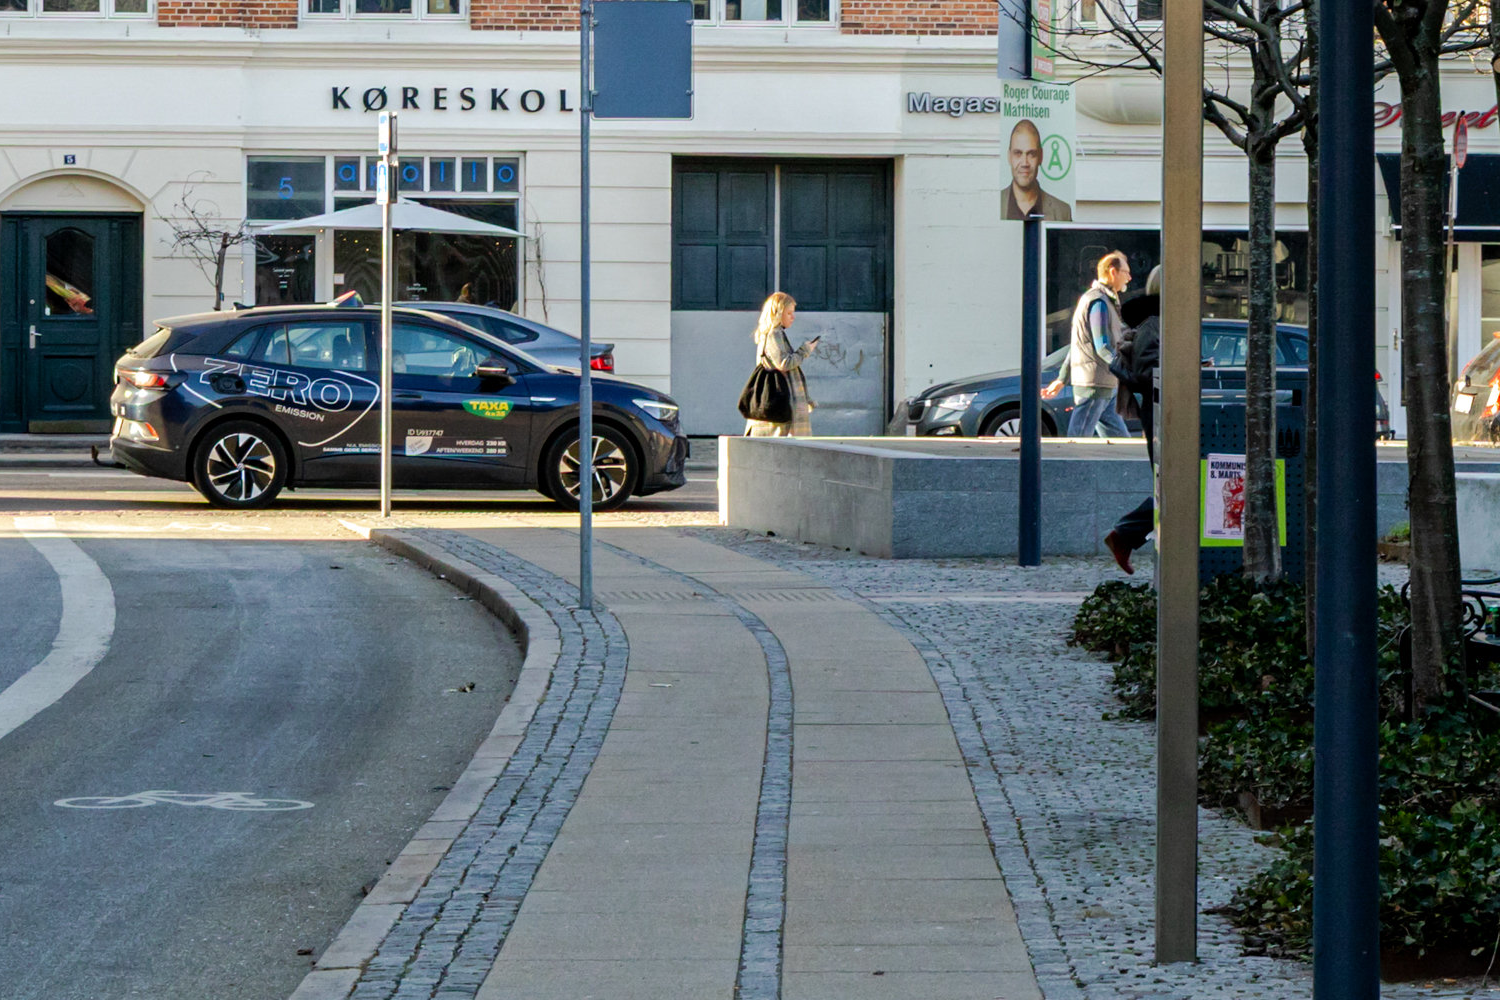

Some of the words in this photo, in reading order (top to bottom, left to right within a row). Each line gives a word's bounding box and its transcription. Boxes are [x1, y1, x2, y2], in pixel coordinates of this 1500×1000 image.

[1003, 83, 1030, 102] Roger
[1032, 85, 1070, 104] Courage
[907, 91, 1000, 118] Magas
[1003, 102, 1050, 119] Matthisen
[277, 176, 294, 200] 5
[200, 357, 352, 412] ZERO
[275, 404, 325, 422] EMISSION
[468, 400, 509, 411] TAXA
[1210, 461, 1246, 471] KOMMUNIS
[1218, 470, 1241, 479] MARTS
